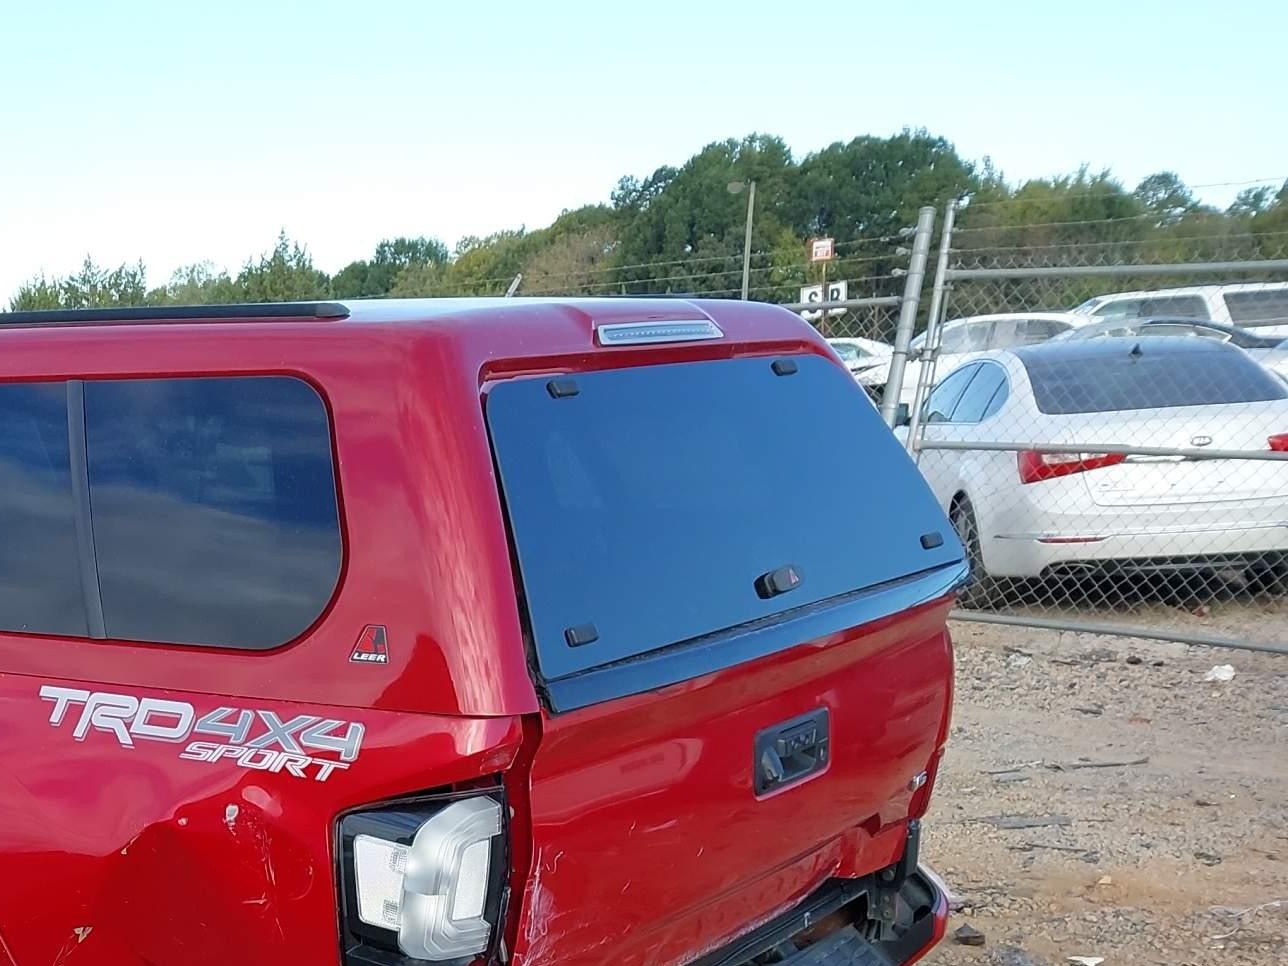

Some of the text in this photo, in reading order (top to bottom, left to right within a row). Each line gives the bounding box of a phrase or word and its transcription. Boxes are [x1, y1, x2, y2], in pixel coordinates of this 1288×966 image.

[353, 652, 386, 662] LEER
[39, 685, 197, 748] TRD
[178, 741, 351, 783] SPORT
